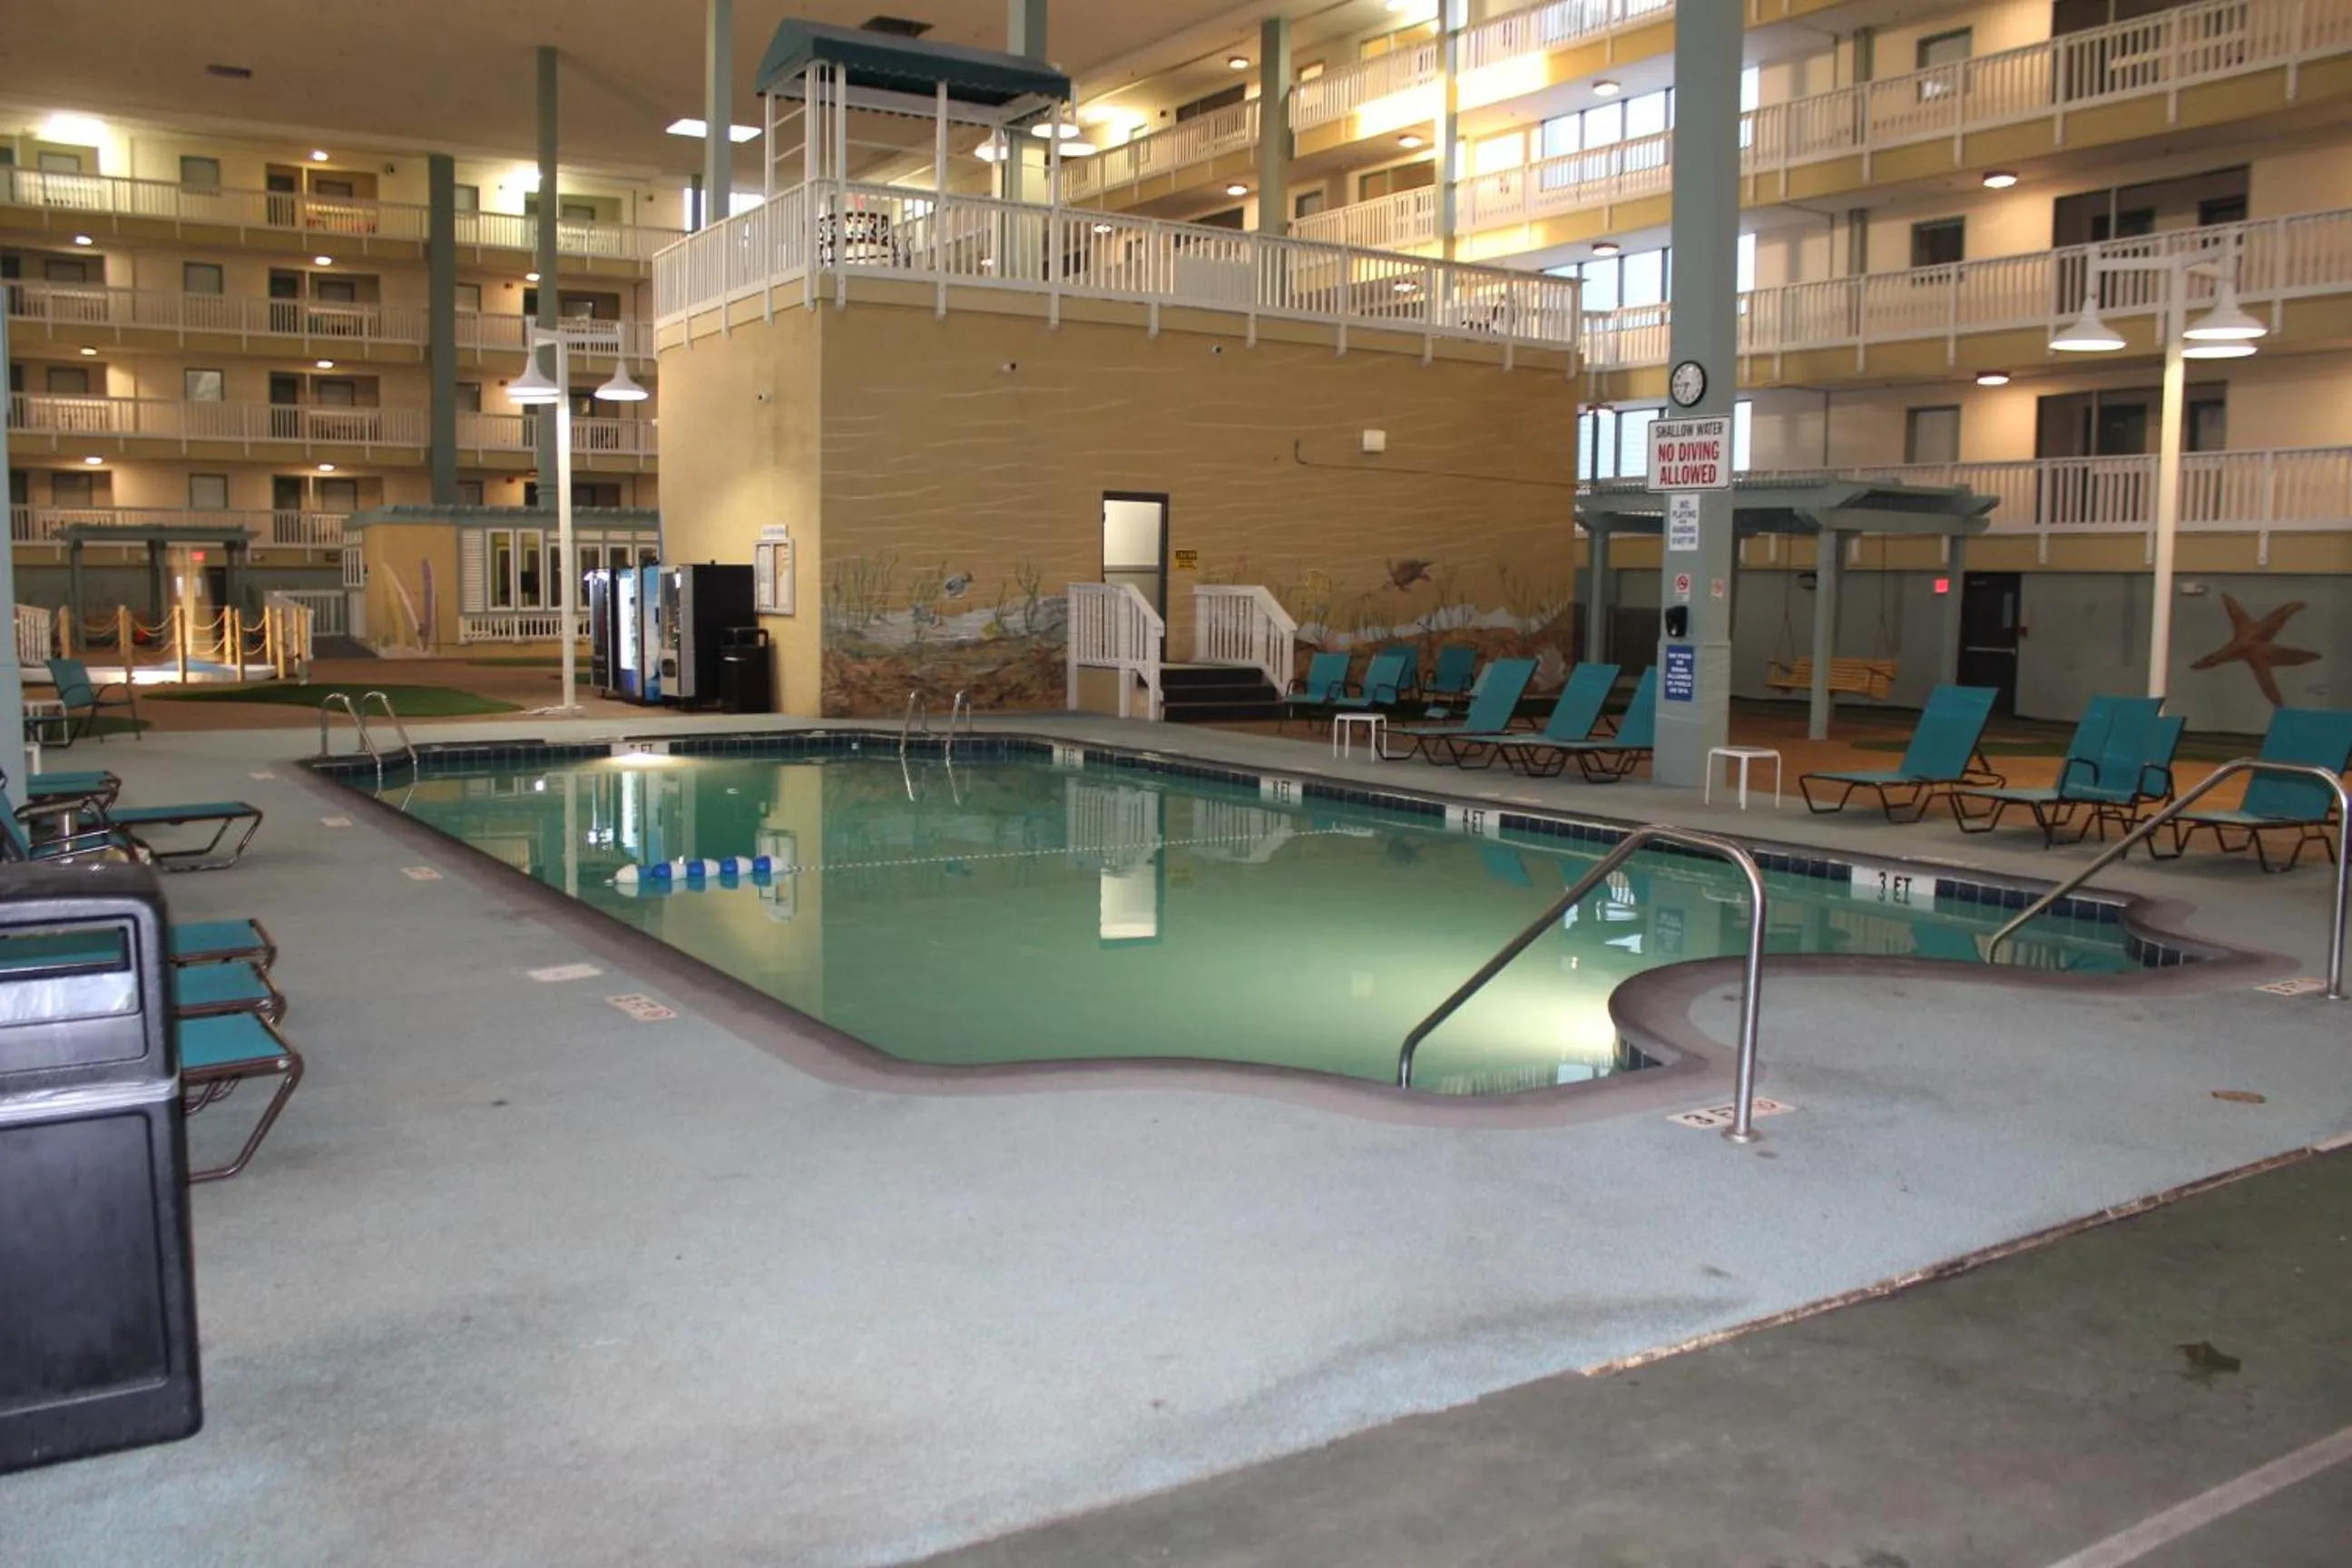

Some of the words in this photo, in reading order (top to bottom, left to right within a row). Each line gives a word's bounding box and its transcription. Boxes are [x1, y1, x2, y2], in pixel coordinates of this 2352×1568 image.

[1655, 426, 1693, 438] SHALLOW
[1697, 422, 1723, 435] WATER
[1658, 443, 1675, 462] NO
[1679, 440, 1720, 460] DIVING
[1660, 465, 1717, 485] ALLOWED
